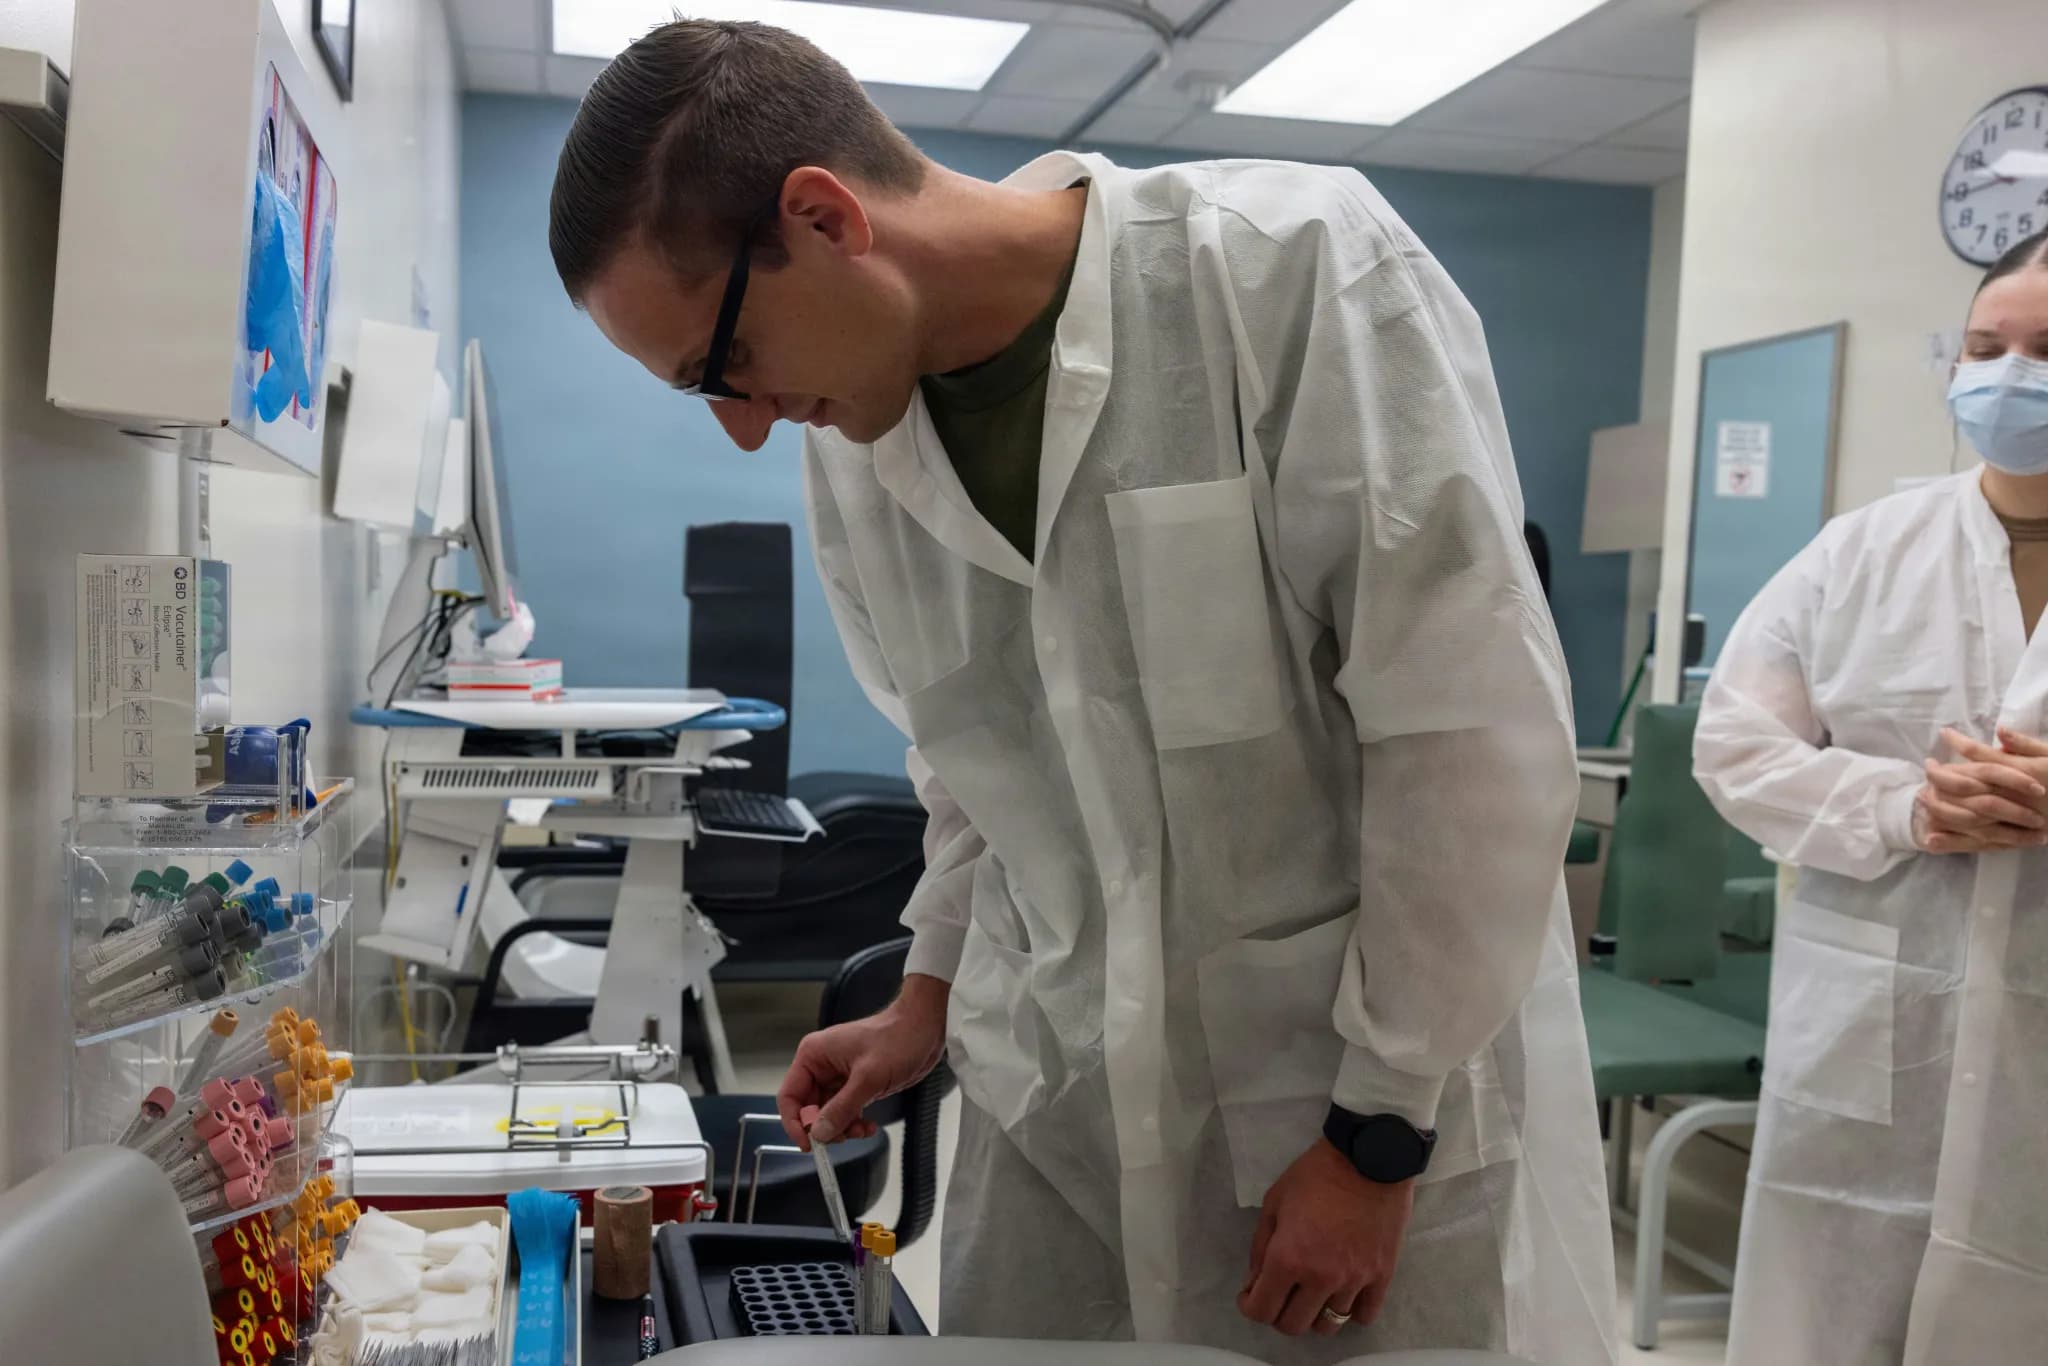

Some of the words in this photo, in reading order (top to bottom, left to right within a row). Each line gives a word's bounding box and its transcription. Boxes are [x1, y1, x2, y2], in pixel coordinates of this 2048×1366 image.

[2005, 107, 2024, 130] 12
[2035, 110, 2042, 129] 1
[1983, 125, 1997, 145] 11
[1954, 182, 1969, 201] 9
[1959, 208, 1973, 227] 8
[2017, 213, 2033, 234] 5
[1975, 224, 1988, 243] 7
[1994, 228, 2008, 248] 6
[176, 582, 187, 600] BD
